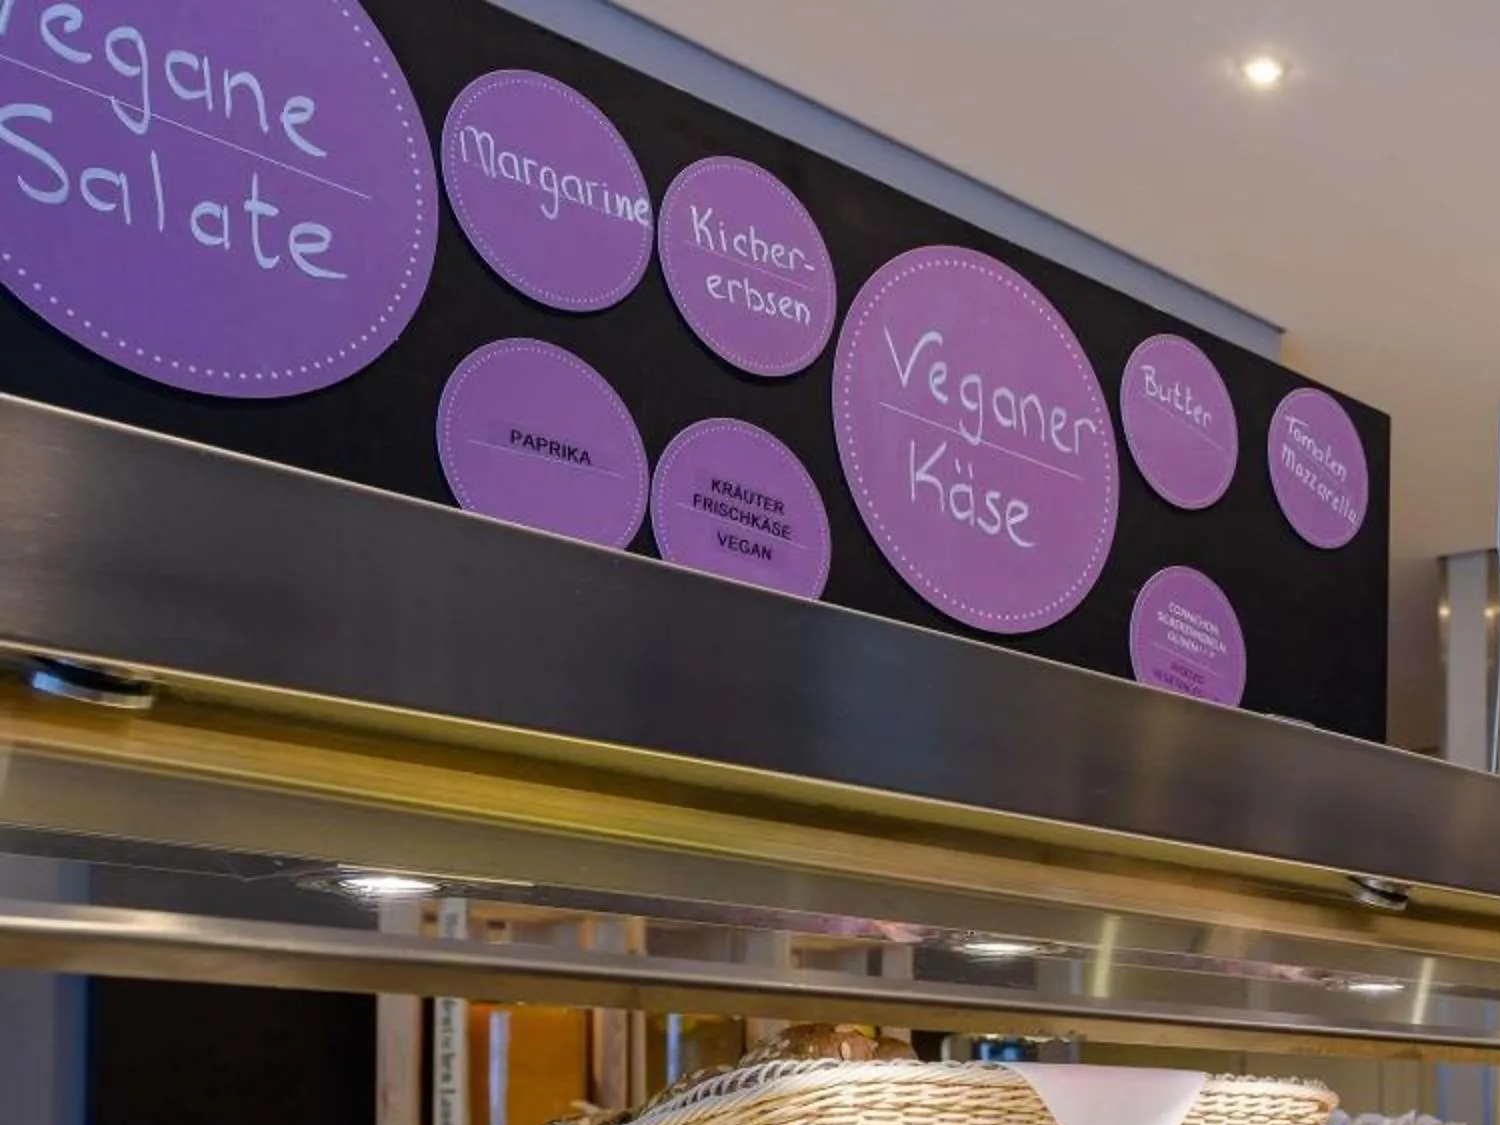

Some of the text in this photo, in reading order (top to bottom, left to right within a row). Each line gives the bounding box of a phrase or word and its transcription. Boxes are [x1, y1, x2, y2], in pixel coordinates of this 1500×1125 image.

[0, 0, 327, 157] egane
[0, 103, 348, 279] Salate
[459, 125, 651, 222] Margarine
[690, 205, 815, 270] Kicher-
[706, 275, 811, 326] erbsen
[884, 325, 1097, 455] Veganer
[1141, 365, 1213, 430] Butter
[510, 429, 592, 466] PAPRIKA
[910, 439, 1036, 547] Käse
[717, 531, 773, 561] VEGAN
